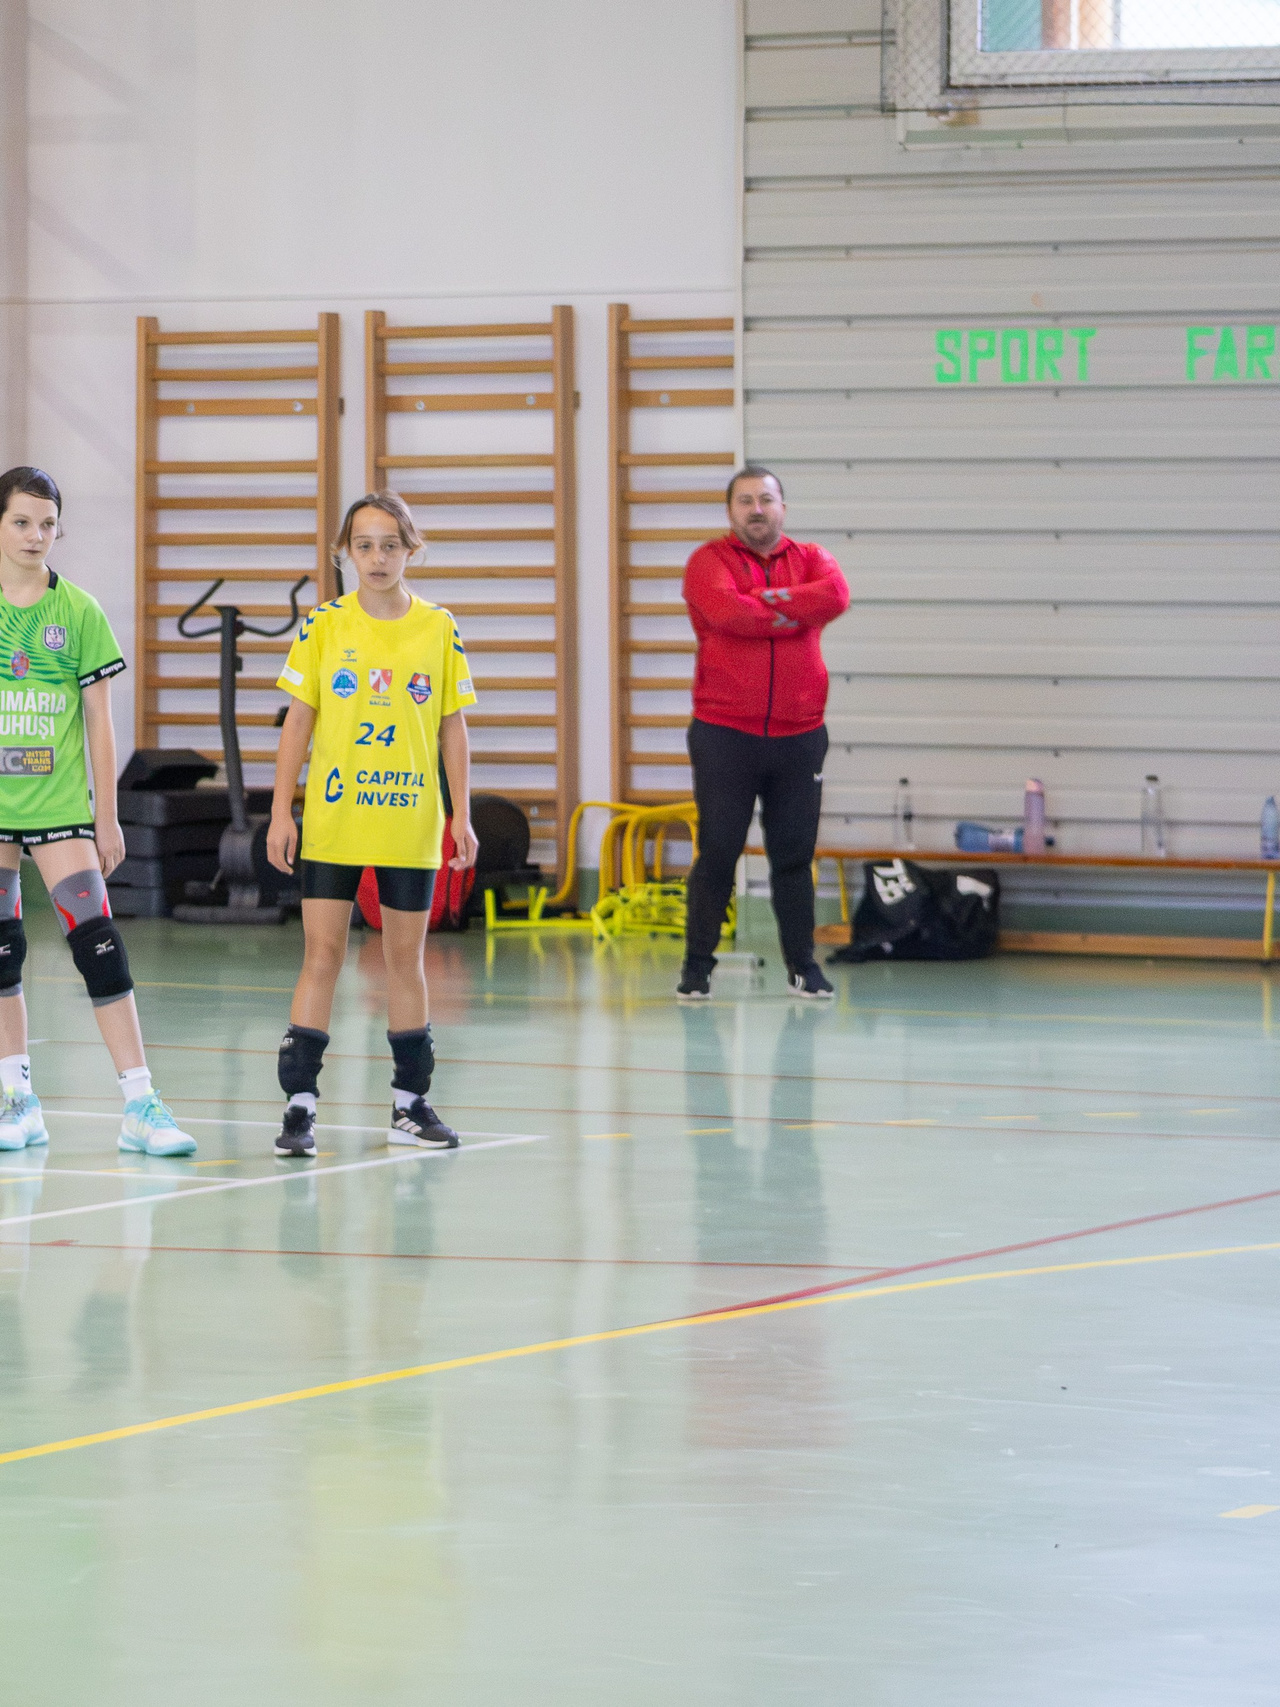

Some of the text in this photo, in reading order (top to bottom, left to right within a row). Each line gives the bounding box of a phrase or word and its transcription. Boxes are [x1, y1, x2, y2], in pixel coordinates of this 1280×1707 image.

[934, 327, 1098, 384] SPORT
[354, 721, 397, 748] 24
[356, 769, 425, 788] CAPITAL
[356, 790, 419, 808] INVEST
